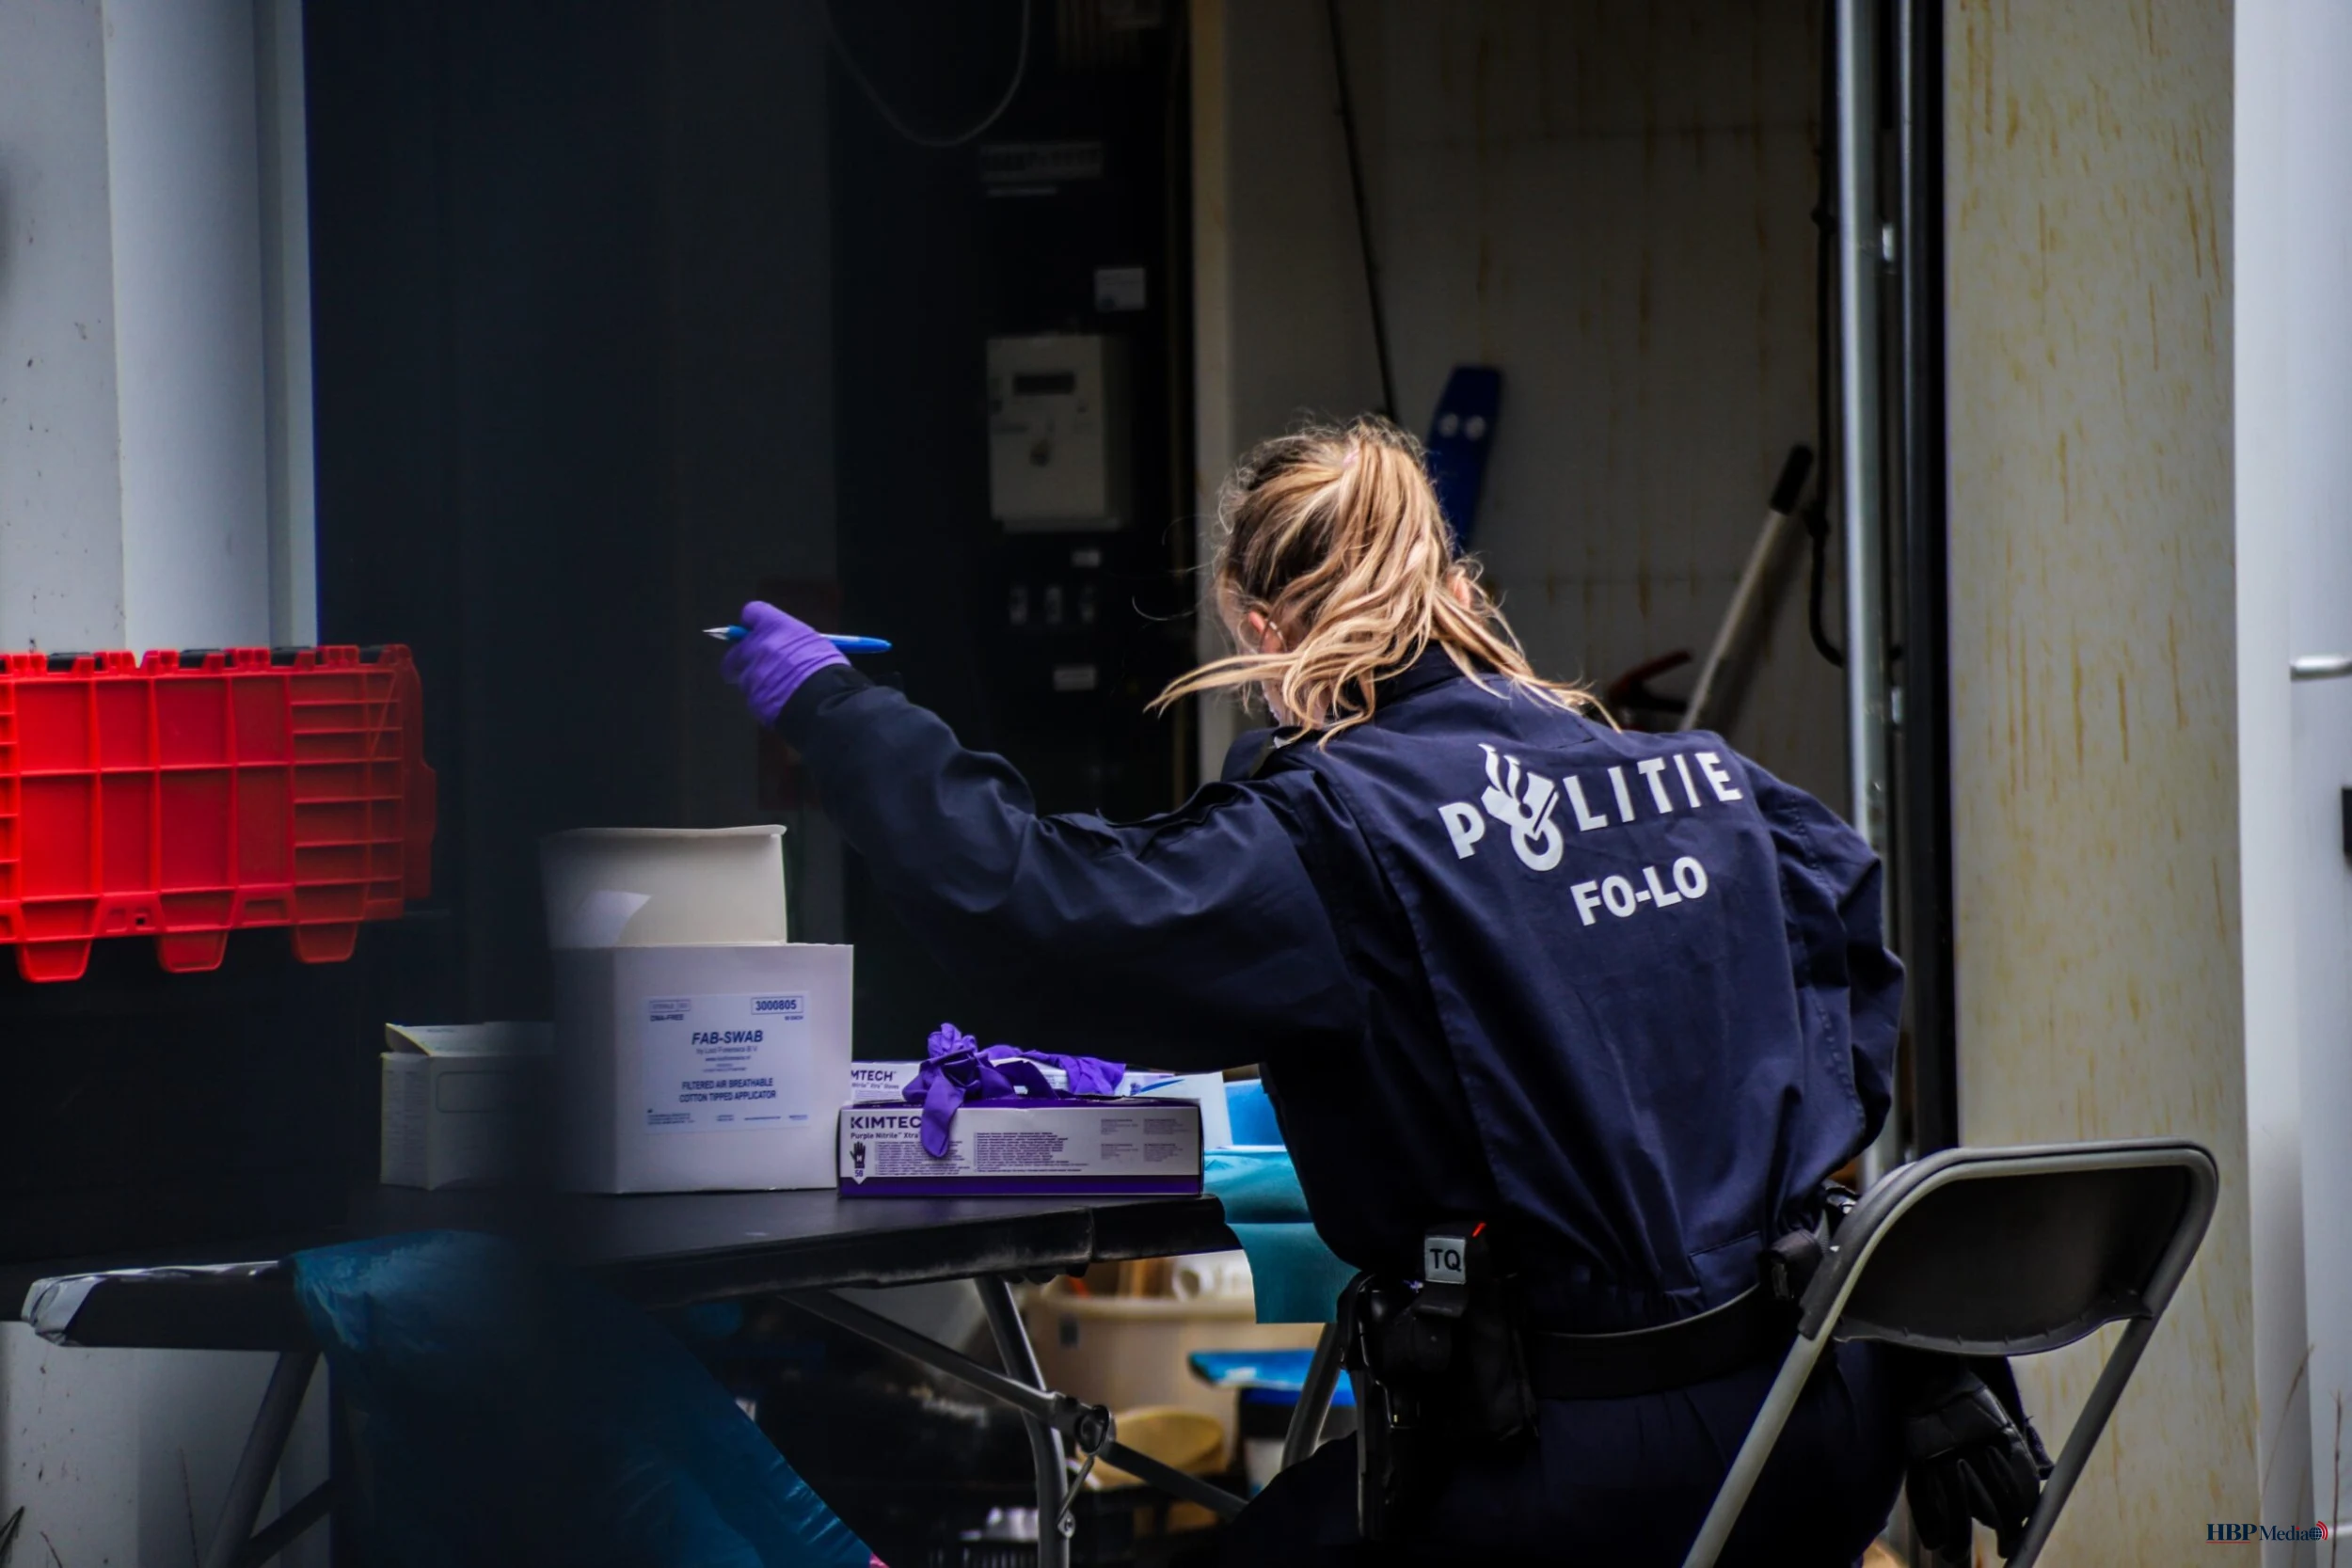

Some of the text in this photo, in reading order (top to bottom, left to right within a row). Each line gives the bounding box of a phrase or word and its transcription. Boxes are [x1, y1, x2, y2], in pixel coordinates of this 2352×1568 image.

[1438, 743, 1743, 871] POLITIE
[1570, 856, 1708, 926] FO-LO
[755, 999, 797, 1011] 3000805
[691, 1030, 764, 1045] FAB-SWAB
[850, 1069, 893, 1082] MTECH
[681, 1077, 773, 1090] FILTERED AIR BREATHABLE
[678, 1090, 776, 1102] COTTON TIPPED APPLICATOR
[850, 1116, 922, 1129] KIMTEC
[850, 1132, 874, 1140] Purple
[1429, 1248, 1462, 1272] TQ
